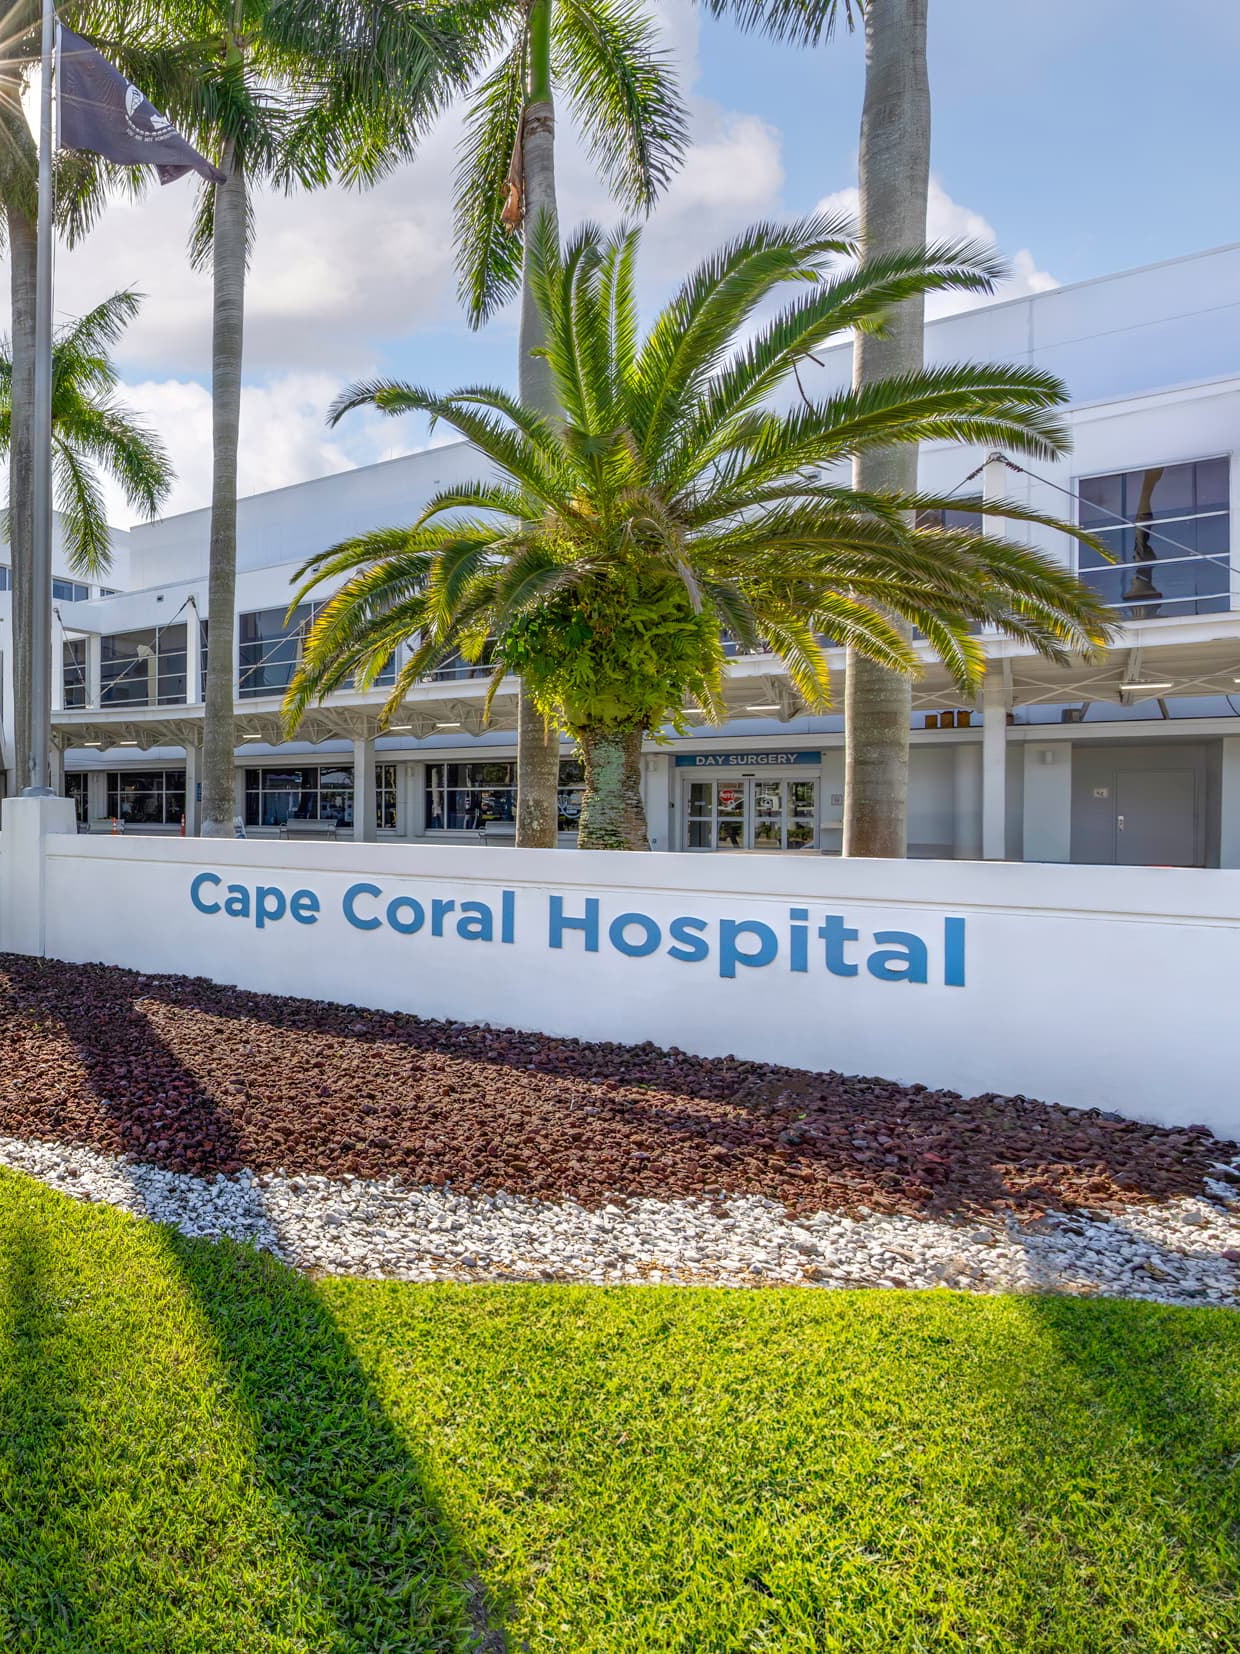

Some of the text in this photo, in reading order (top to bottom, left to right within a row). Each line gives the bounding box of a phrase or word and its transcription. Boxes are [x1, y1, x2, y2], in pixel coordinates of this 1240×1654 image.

[696, 753, 798, 766] DAY SURGERY
[190, 872, 966, 987] Cape Coral Hospital
